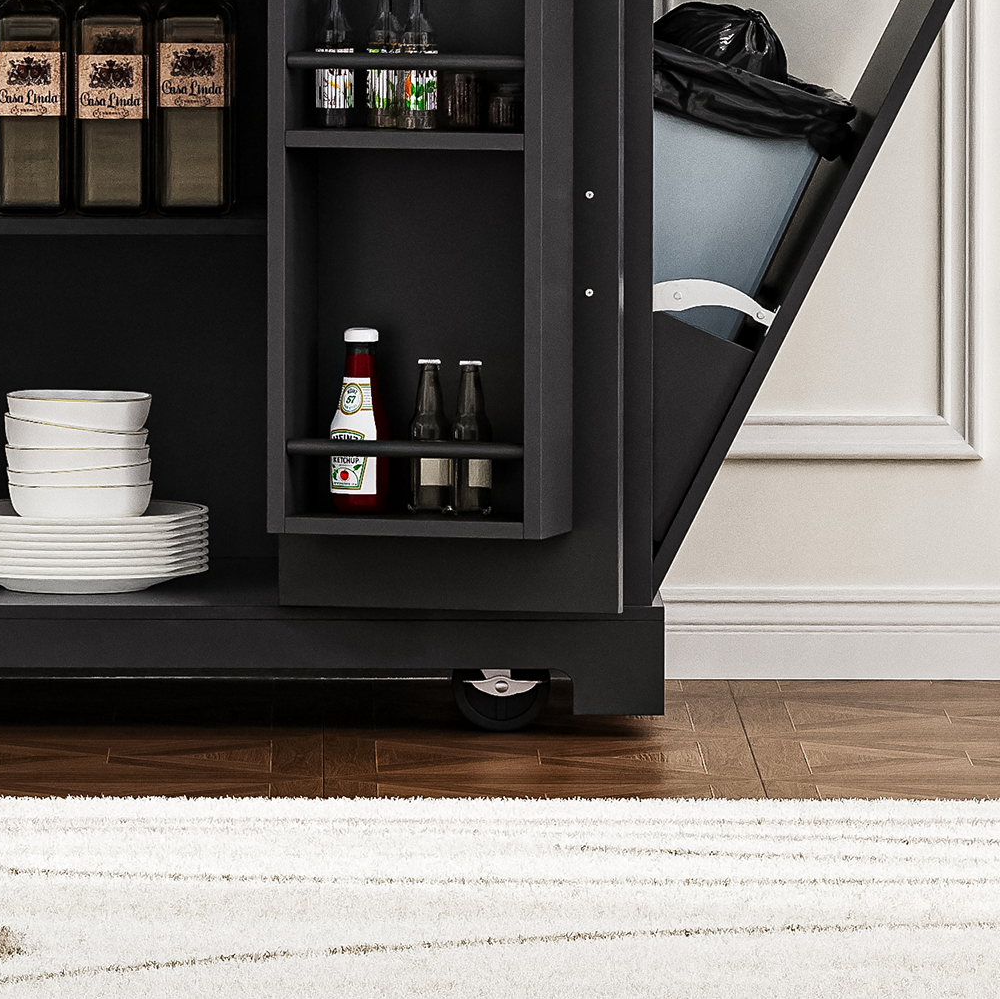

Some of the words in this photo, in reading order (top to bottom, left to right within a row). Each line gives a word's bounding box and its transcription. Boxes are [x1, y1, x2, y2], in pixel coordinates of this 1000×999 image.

[161, 80, 187, 95] Casa
[189, 80, 222, 96] Linda
[25, 89, 59, 105] Linda
[80, 92, 106, 107] Casa
[107, 92, 141, 108] Linda
[345, 395, 357, 404] 57
